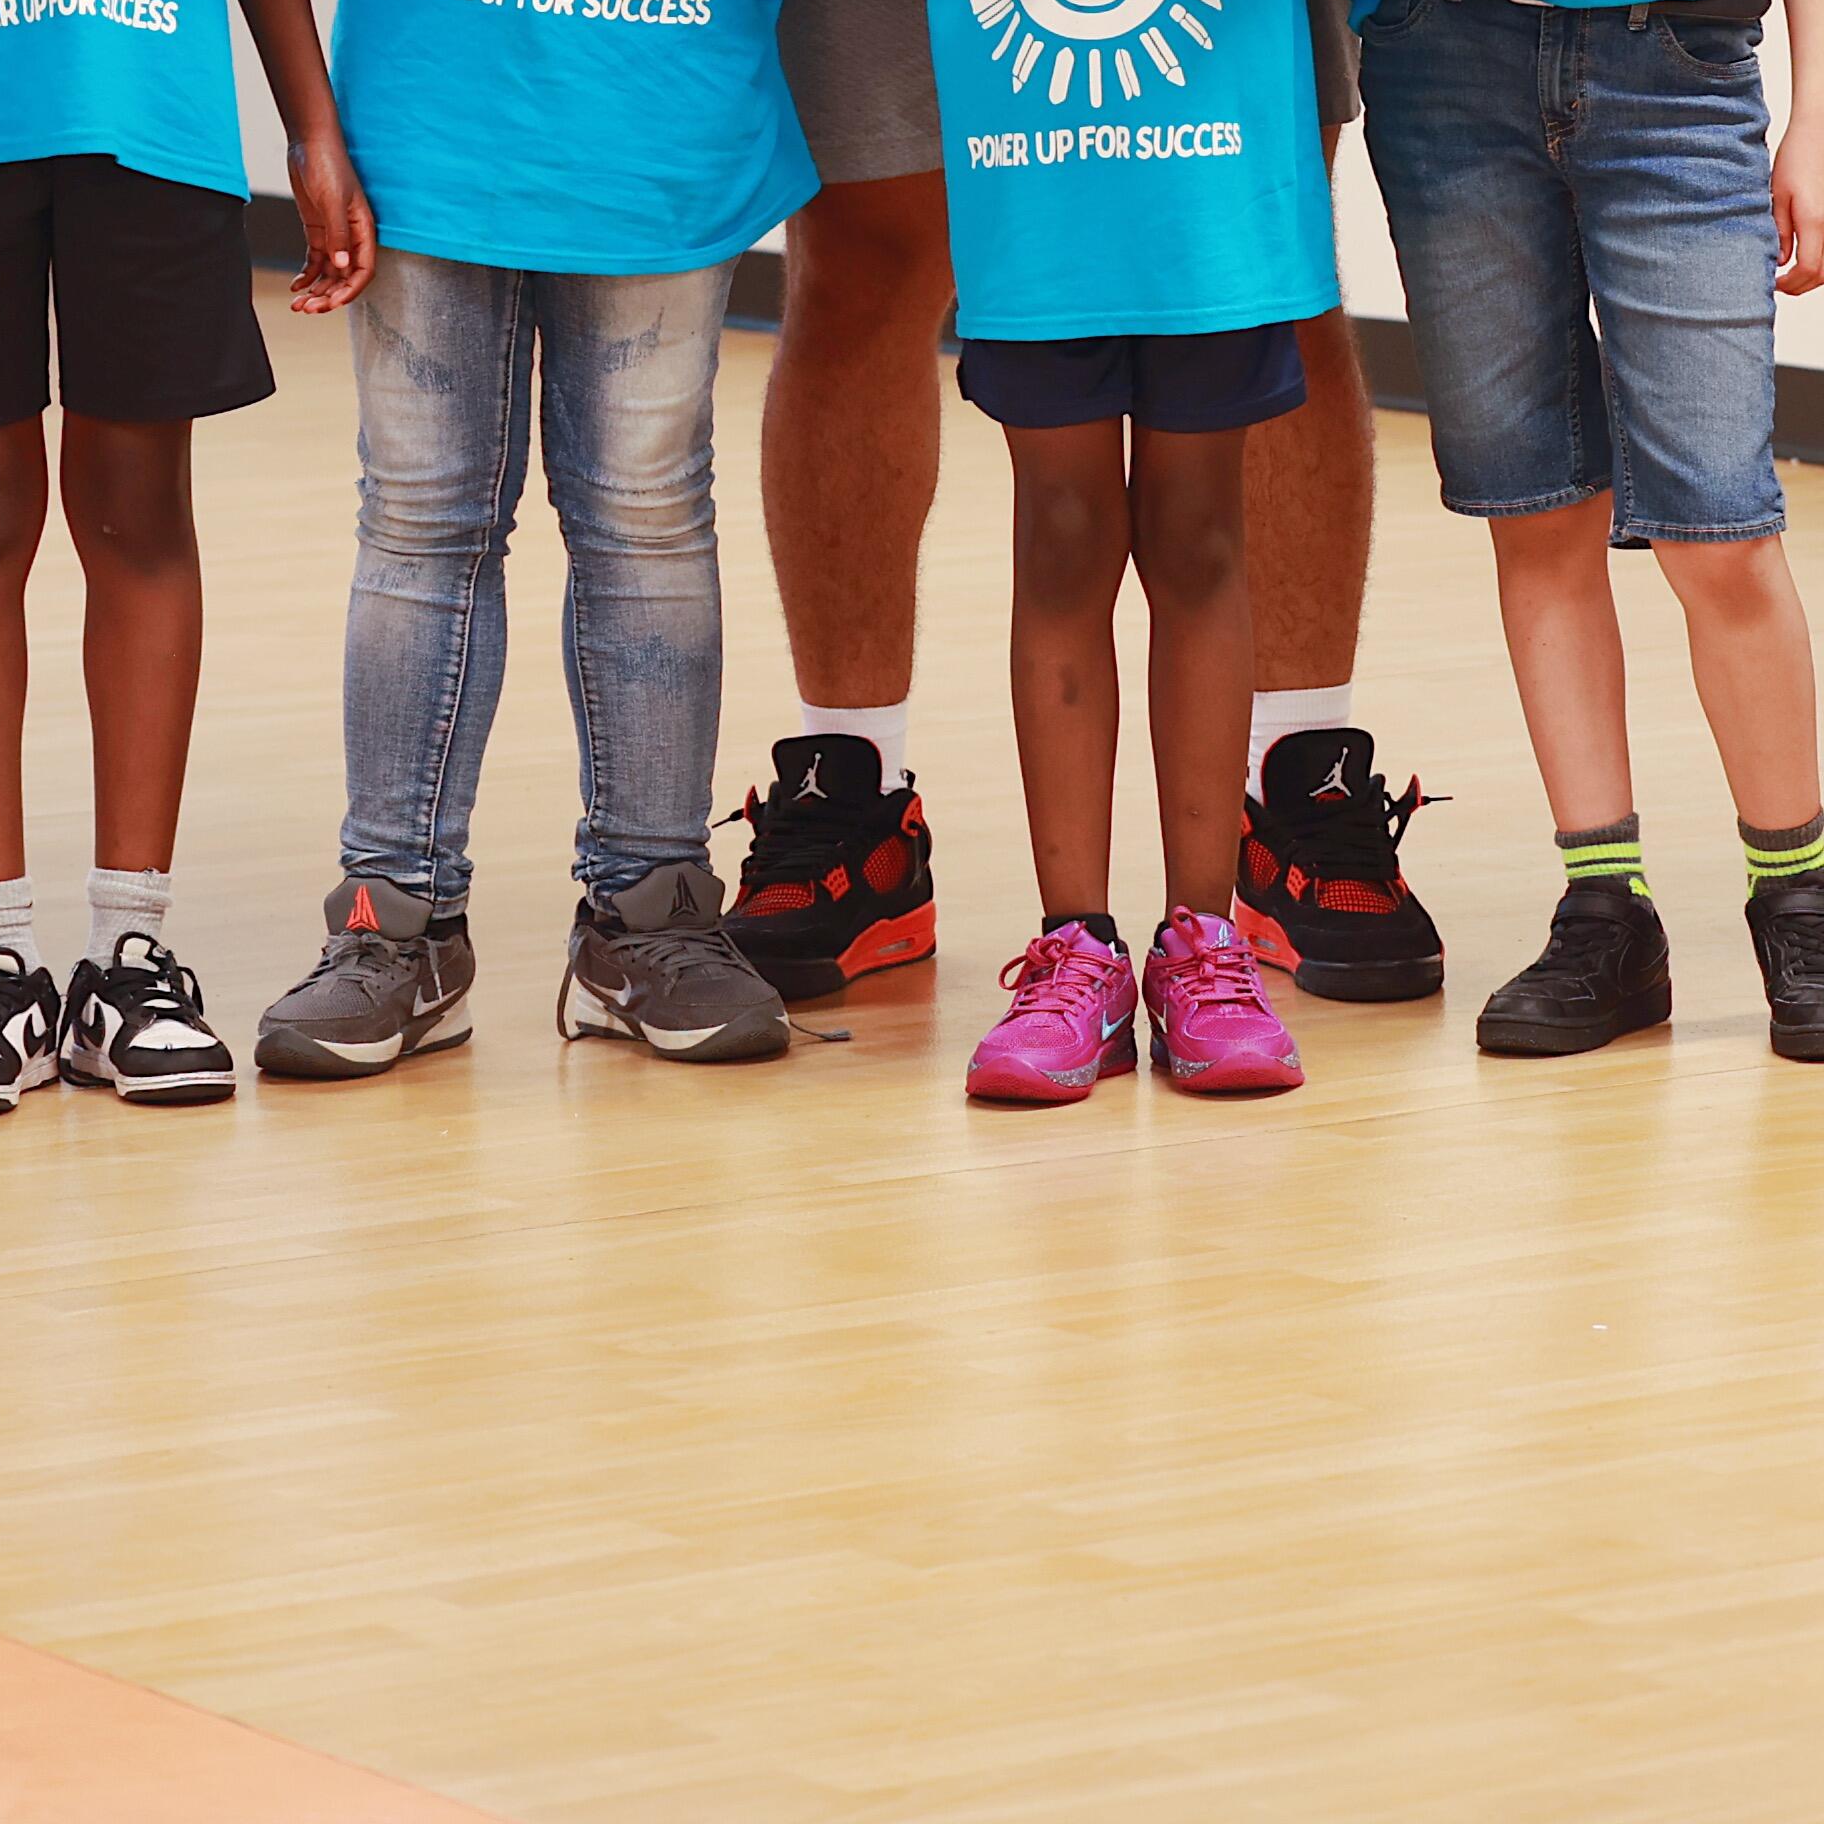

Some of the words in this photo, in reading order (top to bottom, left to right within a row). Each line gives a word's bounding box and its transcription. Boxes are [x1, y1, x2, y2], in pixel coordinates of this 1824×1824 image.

[1035, 129, 1074, 164] UP
[1079, 125, 1130, 160] FOR
[1136, 122, 1241, 160] SUCCESS
